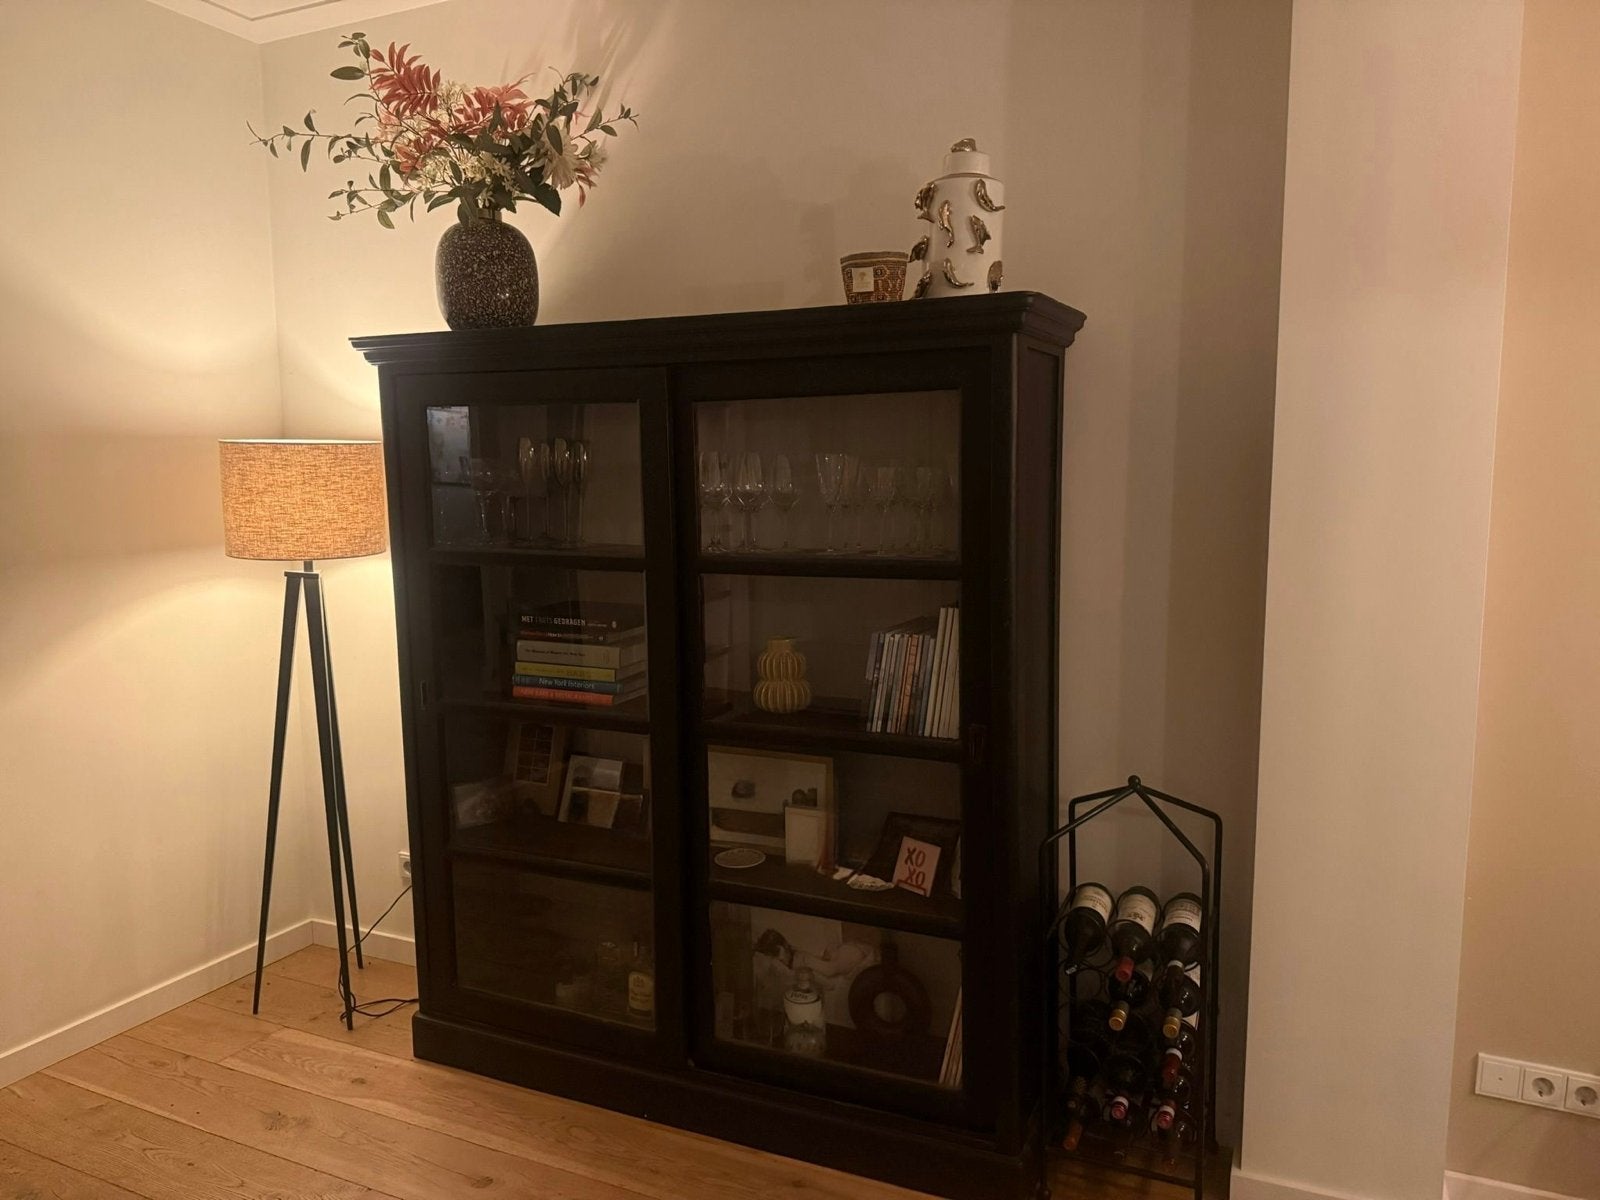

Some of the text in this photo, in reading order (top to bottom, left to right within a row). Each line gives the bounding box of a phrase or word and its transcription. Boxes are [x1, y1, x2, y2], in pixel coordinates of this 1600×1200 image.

[553, 617, 586, 626] GEDRAGEN
[538, 678, 595, 689] New York Interiors
[904, 846, 926, 867] XO
[904, 866, 926, 887] XO
